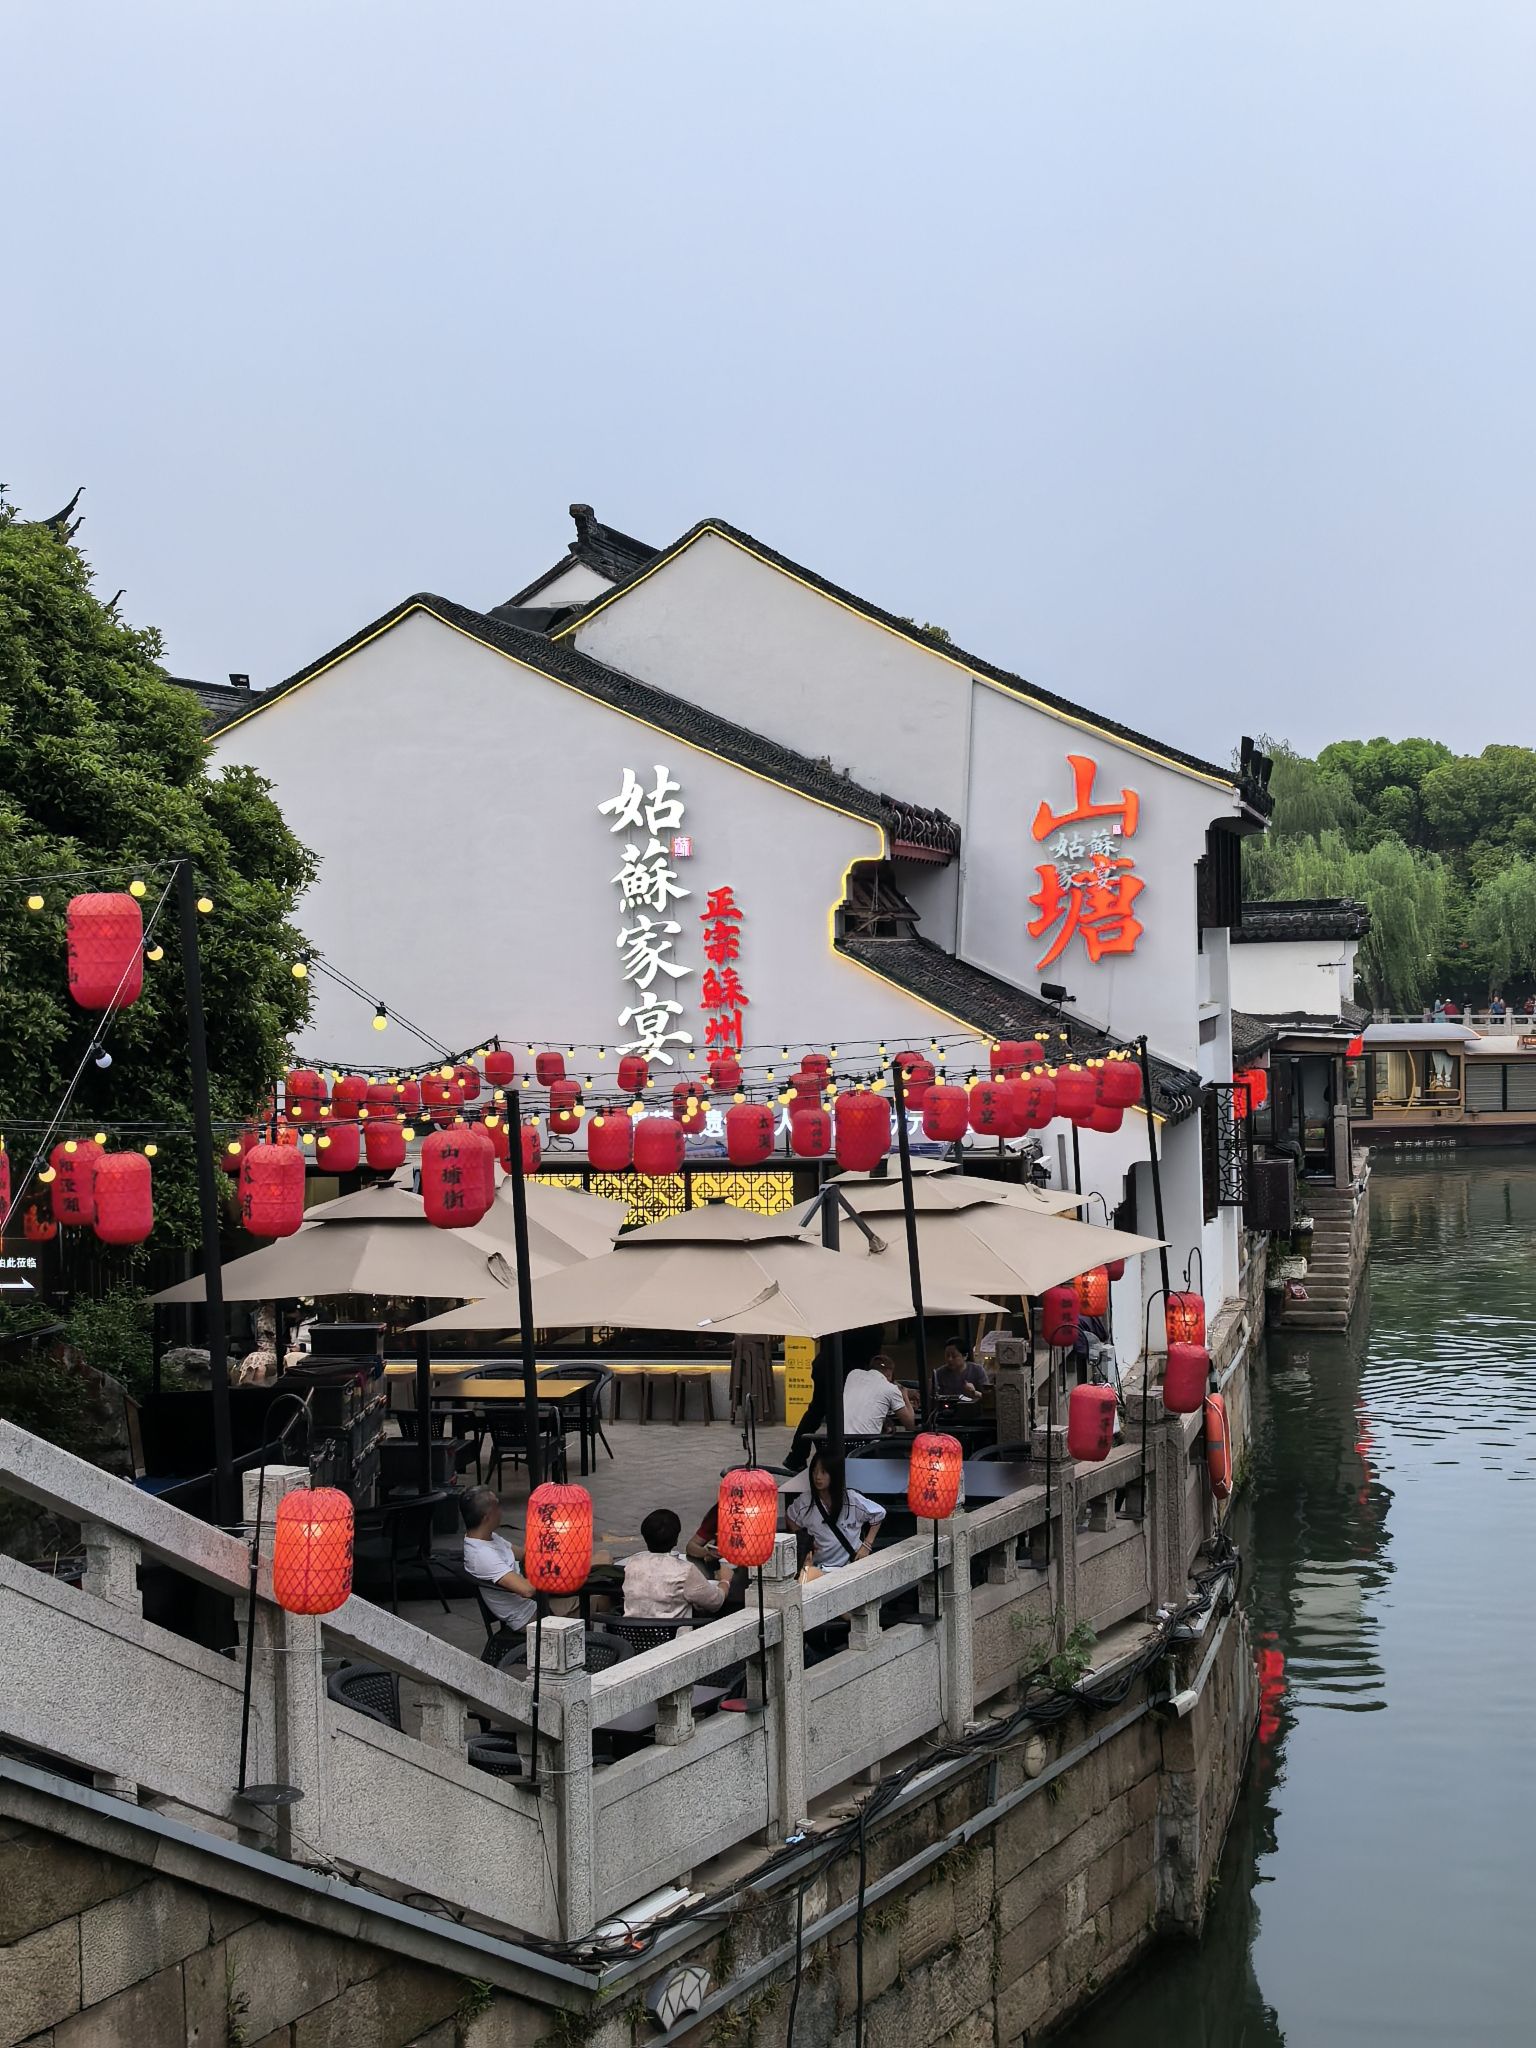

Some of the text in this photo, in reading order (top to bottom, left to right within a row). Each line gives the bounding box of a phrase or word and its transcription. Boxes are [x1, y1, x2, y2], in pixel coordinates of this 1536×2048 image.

[1027, 753, 1146, 972] 山塘
[699, 885, 749, 1084] 正宗蘇州
